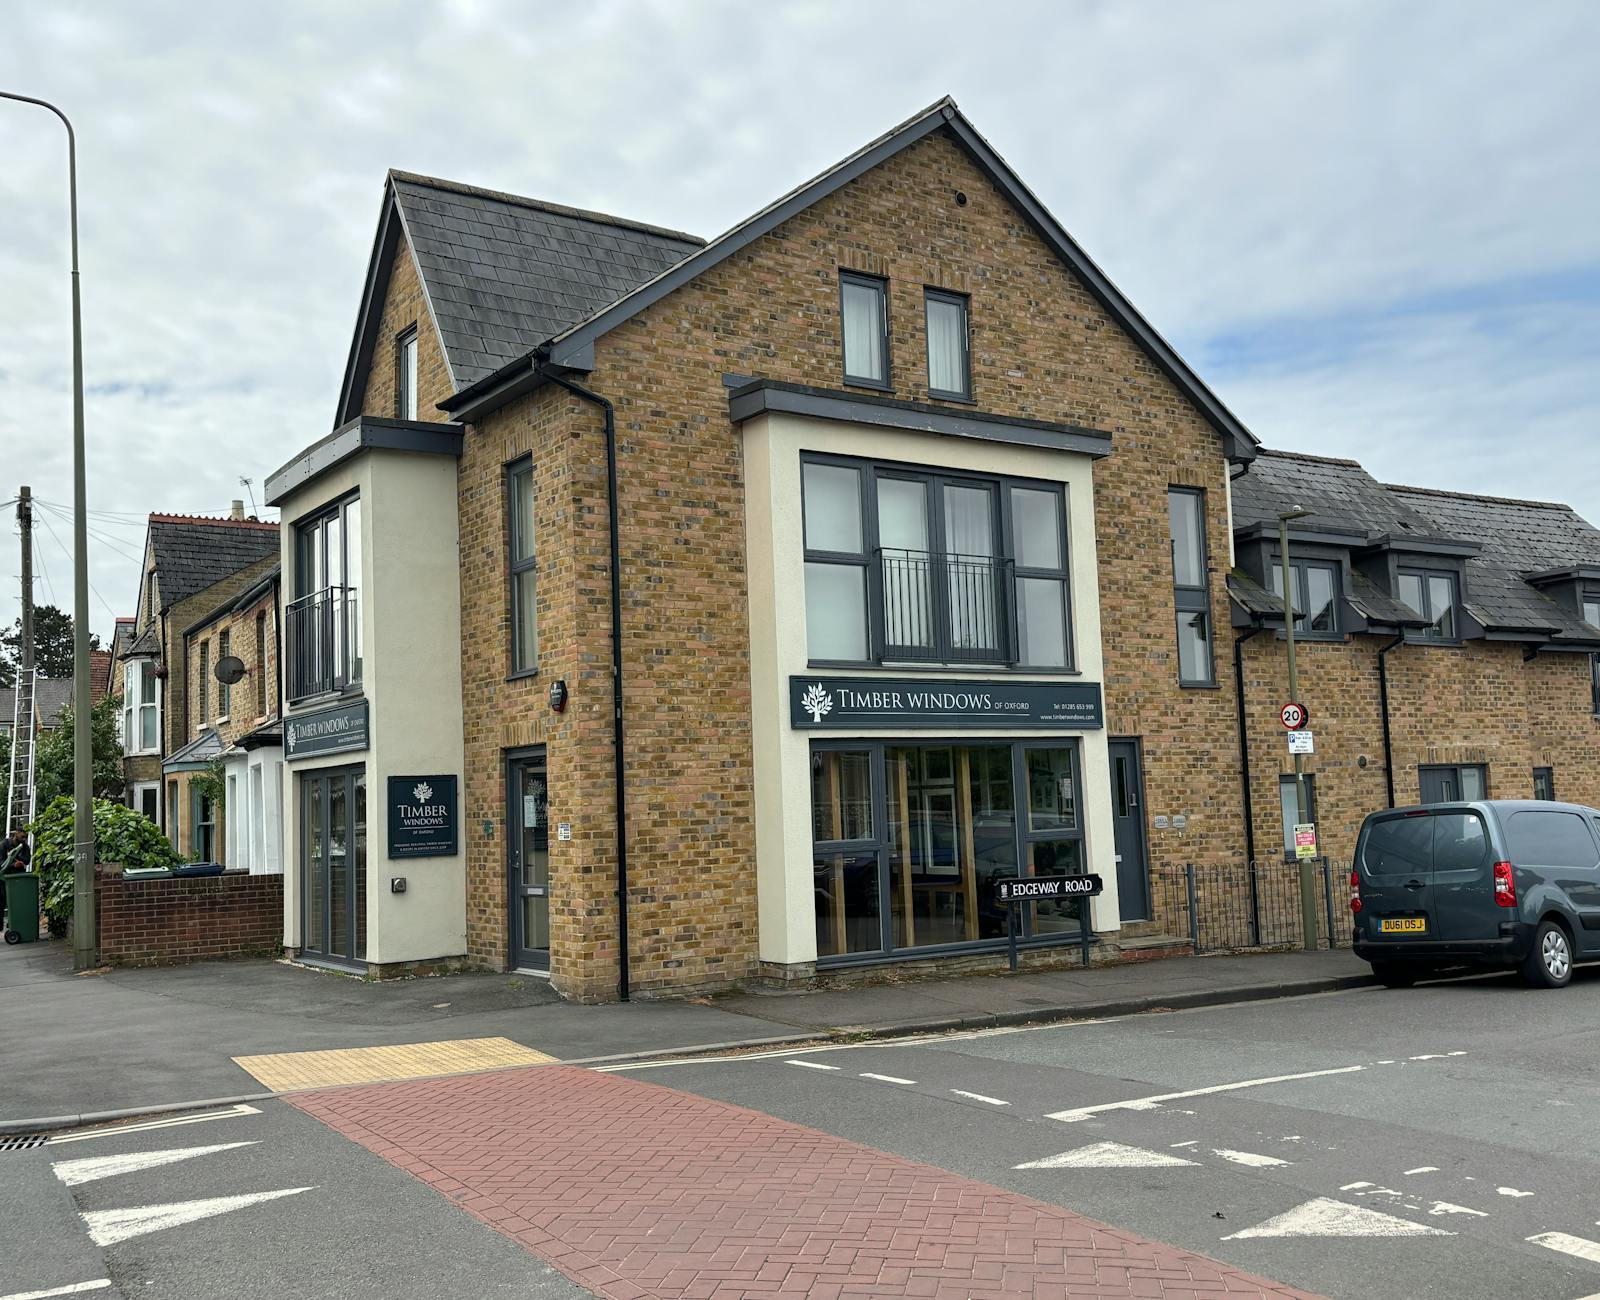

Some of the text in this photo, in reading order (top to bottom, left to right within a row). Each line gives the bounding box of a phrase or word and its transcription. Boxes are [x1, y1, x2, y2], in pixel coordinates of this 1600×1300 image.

[837, 689, 904, 708] TIMBER
[907, 692, 991, 710] WINDOWS
[1004, 702, 1030, 710] OXFORD
[1284, 711, 1299, 721] 20
[296, 723, 318, 738] TIMBER
[318, 716, 349, 734] WINDOWS
[397, 804, 448, 818] TIMBER
[403, 817, 444, 826] WINDOWS
[1012, 879, 1093, 896] EDGEWAY ROAD
